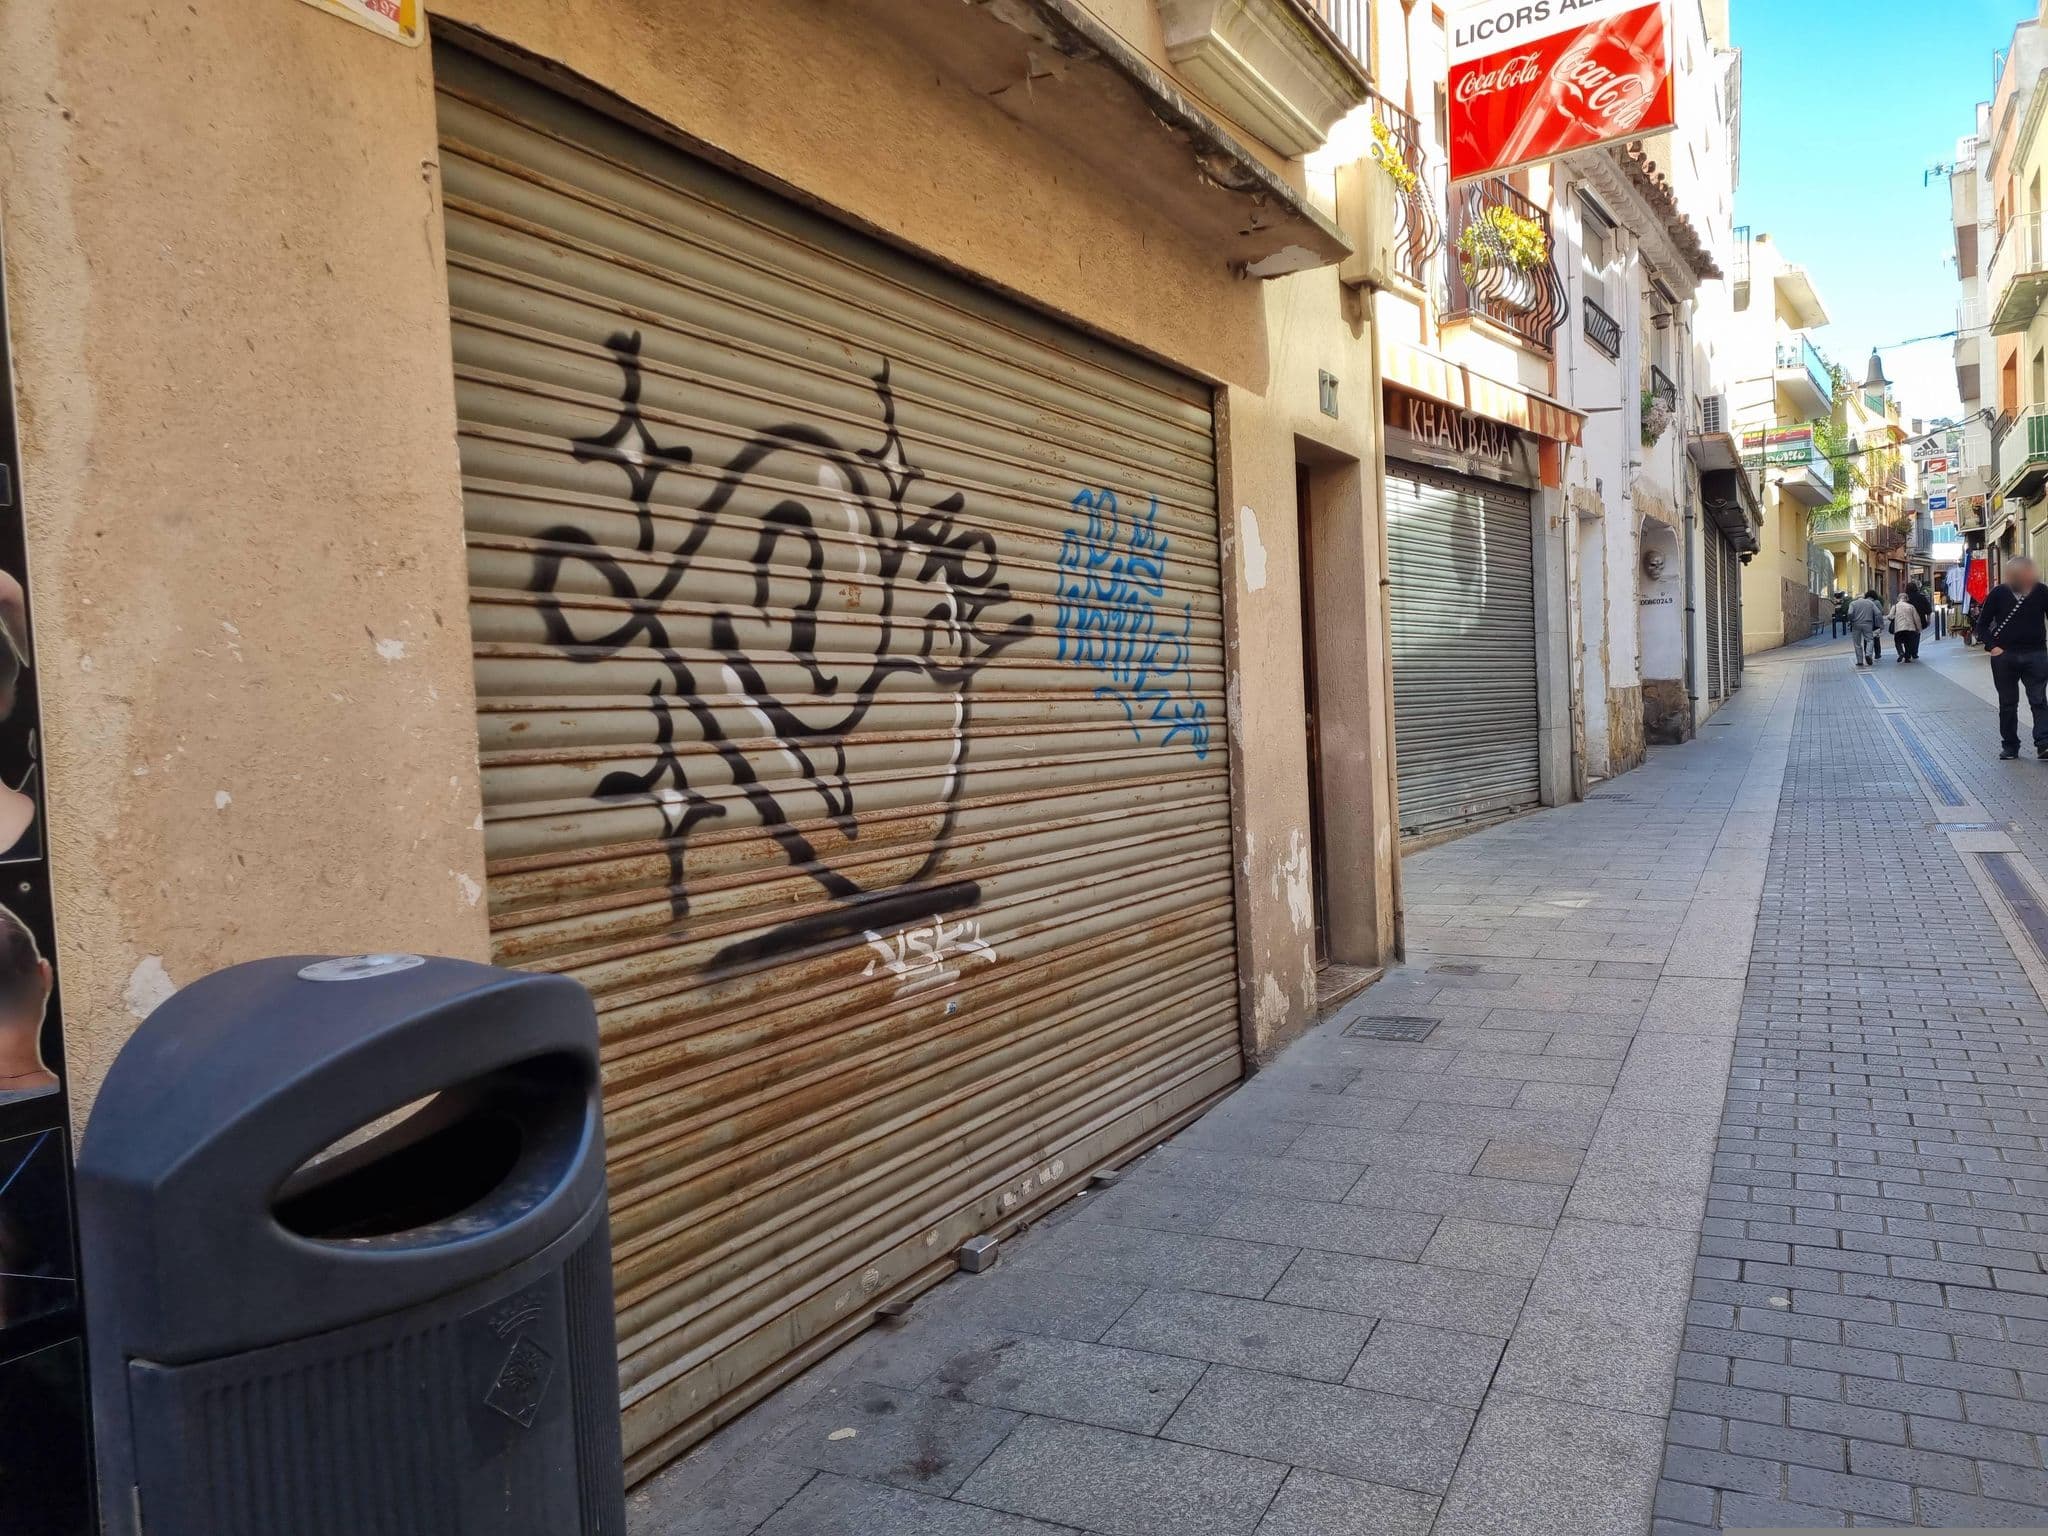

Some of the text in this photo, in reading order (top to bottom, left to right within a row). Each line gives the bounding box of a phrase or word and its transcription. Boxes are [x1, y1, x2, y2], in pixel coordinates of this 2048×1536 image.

[1455, 0, 1550, 48] LICORS
[1454, 50, 1543, 102] Coca-Cola
[1551, 47, 1654, 128] Coca-Cola
[1409, 398, 1513, 465] KHAN BABA
[1913, 448, 1945, 458] adidas
